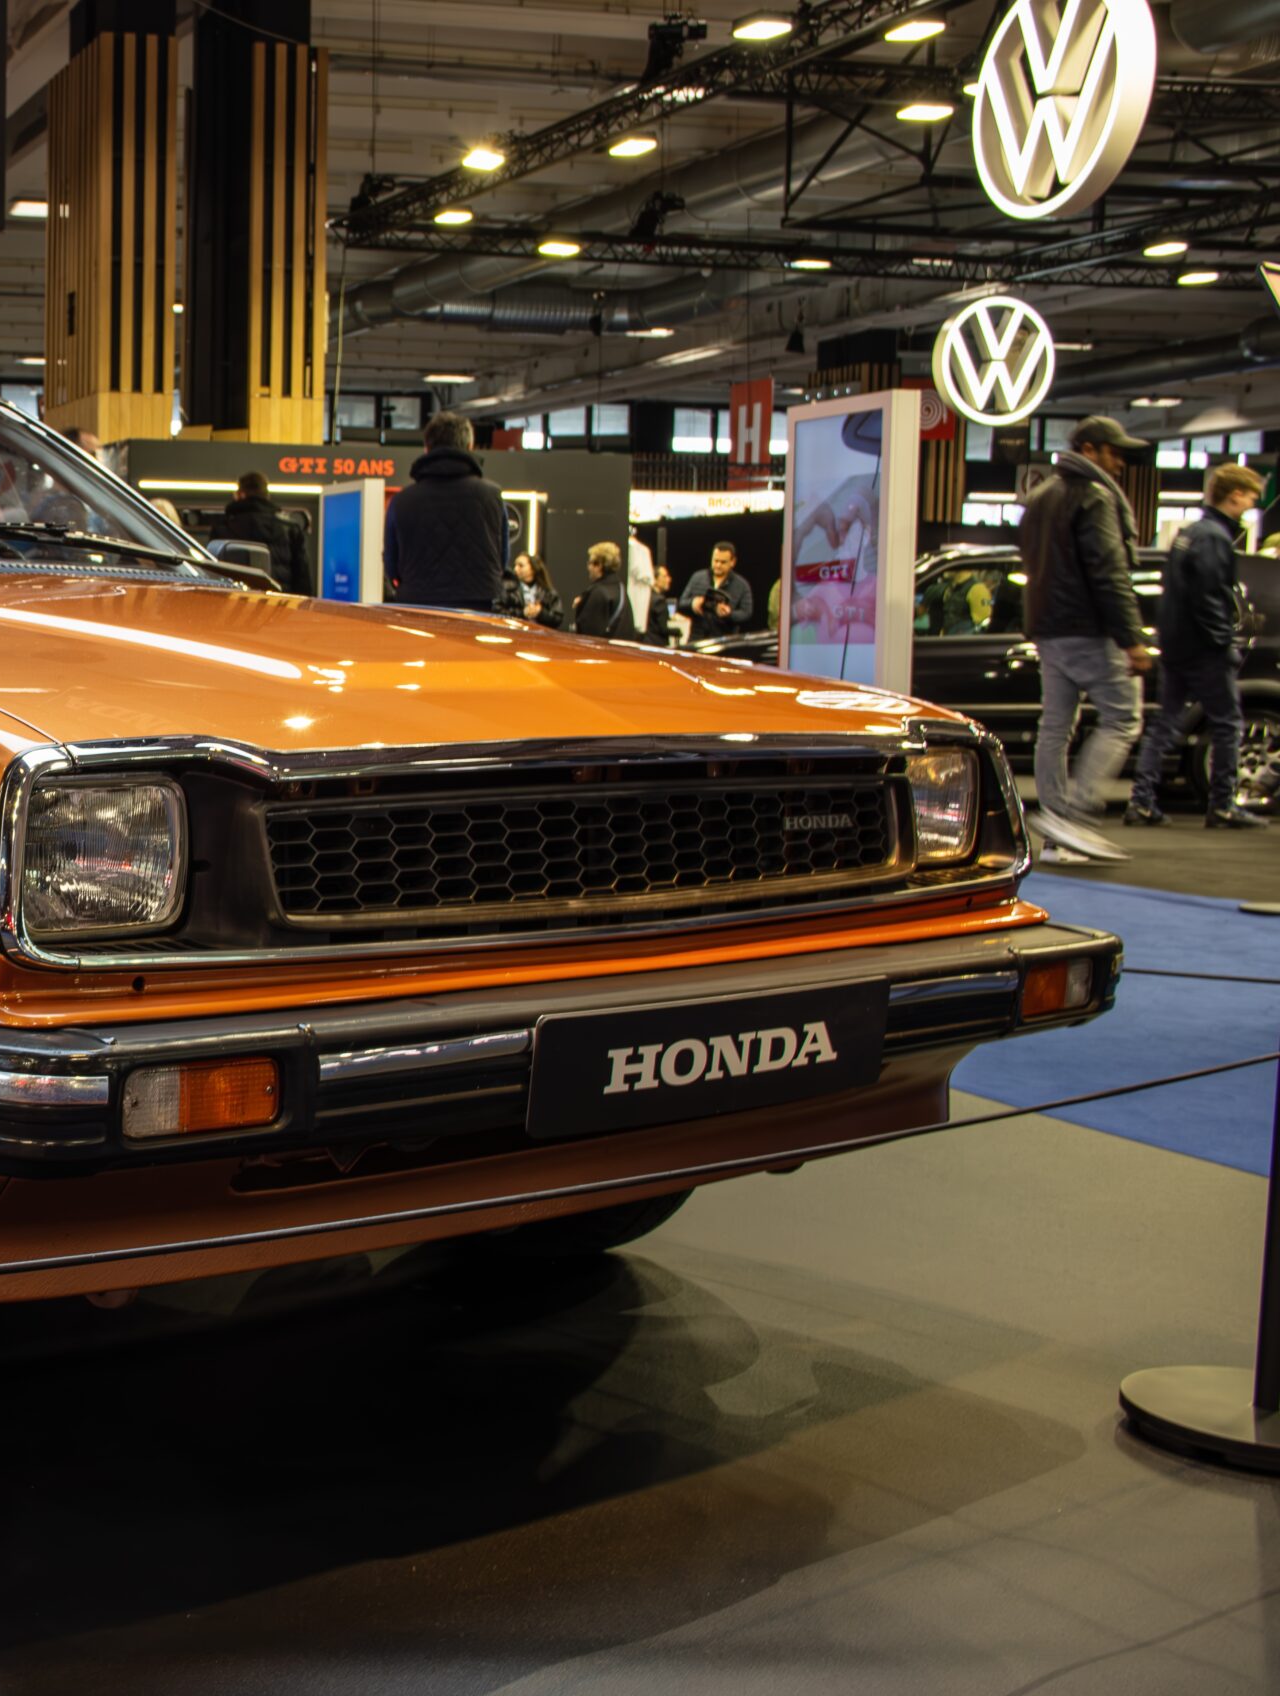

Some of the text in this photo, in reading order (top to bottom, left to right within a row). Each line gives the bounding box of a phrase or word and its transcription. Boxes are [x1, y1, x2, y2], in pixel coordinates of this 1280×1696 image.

[946, 302, 1050, 414] VW
[737, 402, 761, 464] H
[278, 457, 395, 477] GTI 50 ANS
[819, 564, 849, 579] GTI
[784, 814, 853, 830] HONDA
[603, 1021, 837, 1095] HONDA
